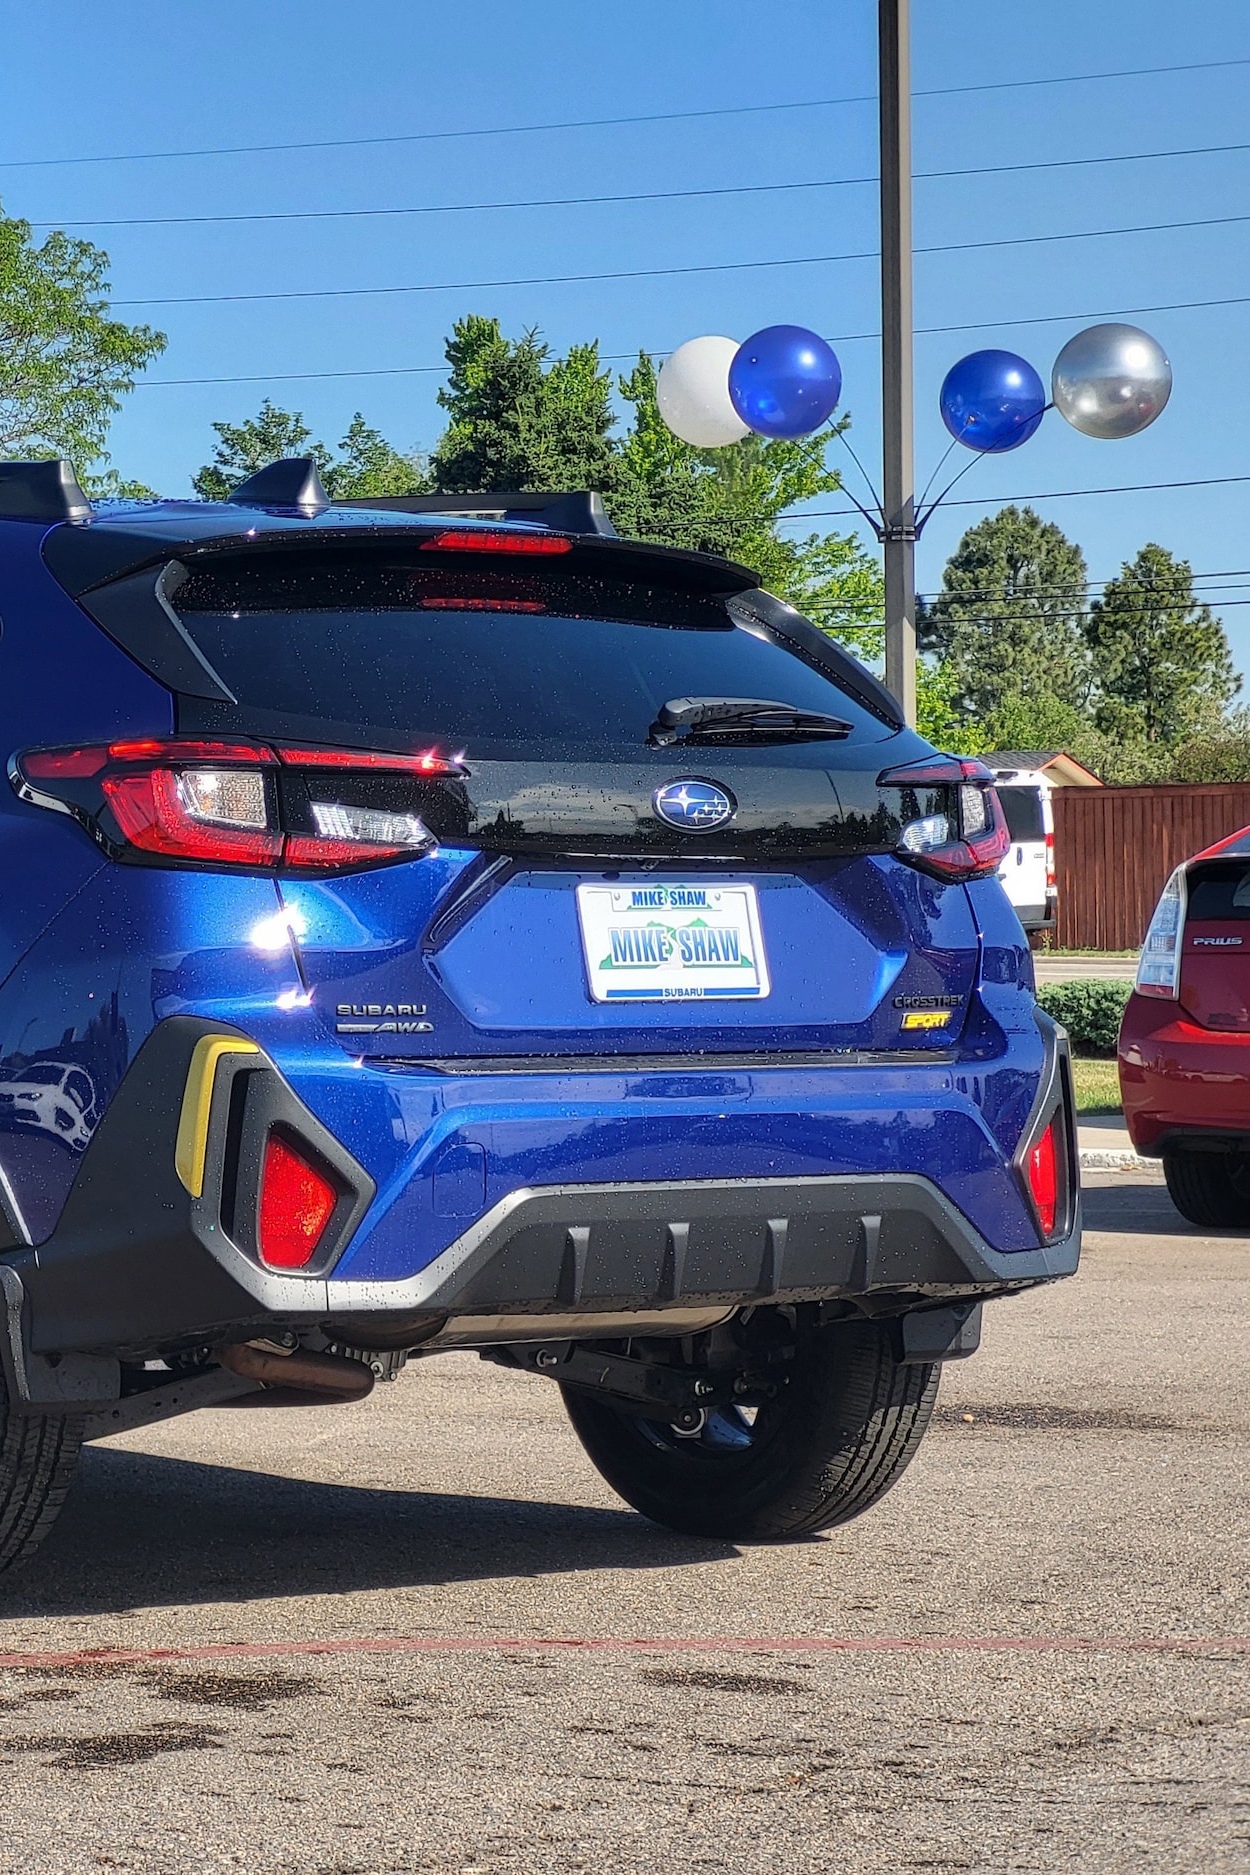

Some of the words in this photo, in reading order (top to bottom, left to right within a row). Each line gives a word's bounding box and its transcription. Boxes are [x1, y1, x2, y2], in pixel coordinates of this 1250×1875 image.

[631, 891, 665, 906] MIKE
[670, 890, 707, 906] SHAW
[610, 929, 669, 962] MIKE
[677, 928, 740, 962] SHAW
[1193, 937, 1243, 946] PRIUS
[664, 988, 703, 997] SUBARU
[893, 993, 965, 1009] CROSSTREK
[337, 1003, 428, 1016] SUBARU
[374, 1022, 435, 1034] AWD
[904, 1013, 950, 1029] SPORT
